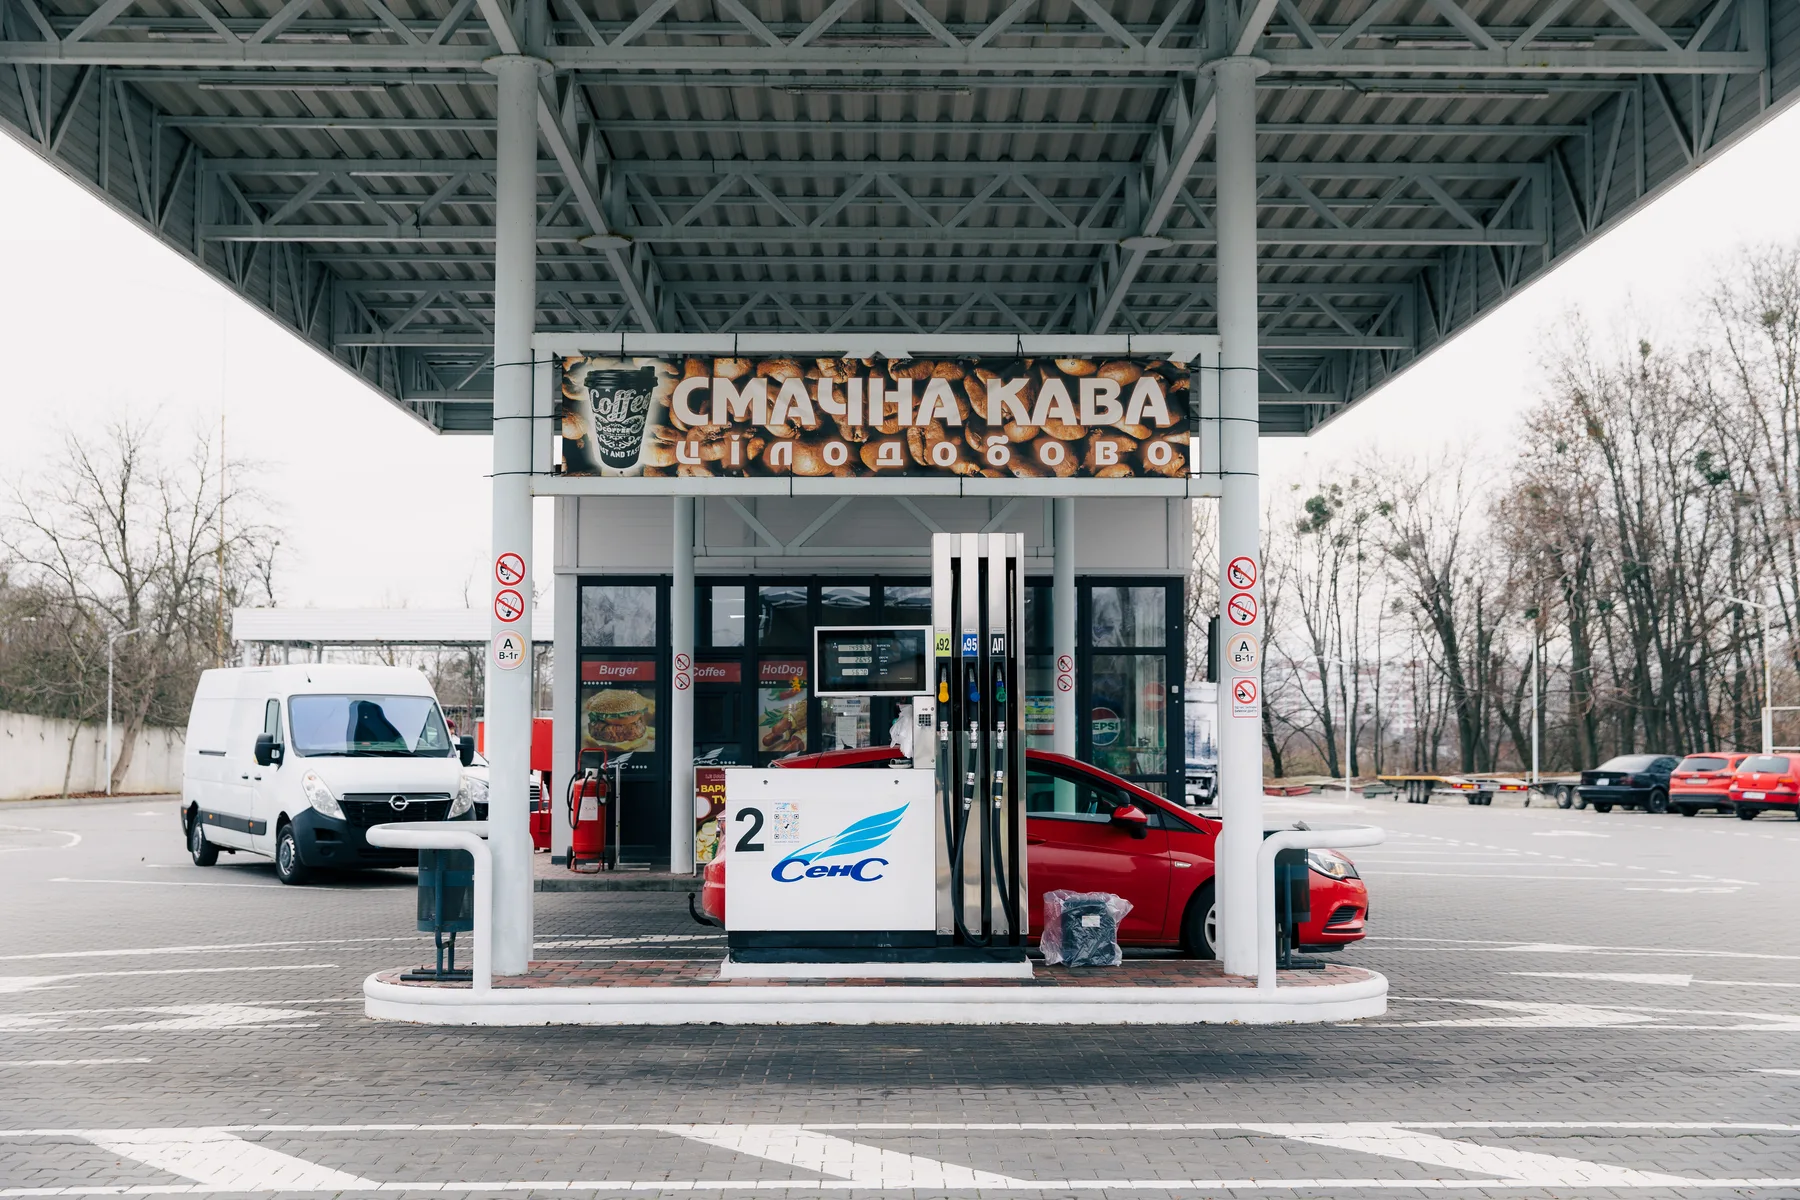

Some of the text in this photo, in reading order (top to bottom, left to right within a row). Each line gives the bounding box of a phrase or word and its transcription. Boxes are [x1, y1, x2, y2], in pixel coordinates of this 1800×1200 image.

[672, 376, 1171, 426] СМАЧНА КАВА
[992, 638, 1004, 653] ДП
[599, 665, 637, 675] Burger
[693, 667, 726, 677] Coffee
[762, 664, 804, 676] HotDog
[1092, 722, 1118, 731] EPSI
[735, 807, 765, 852] 2
